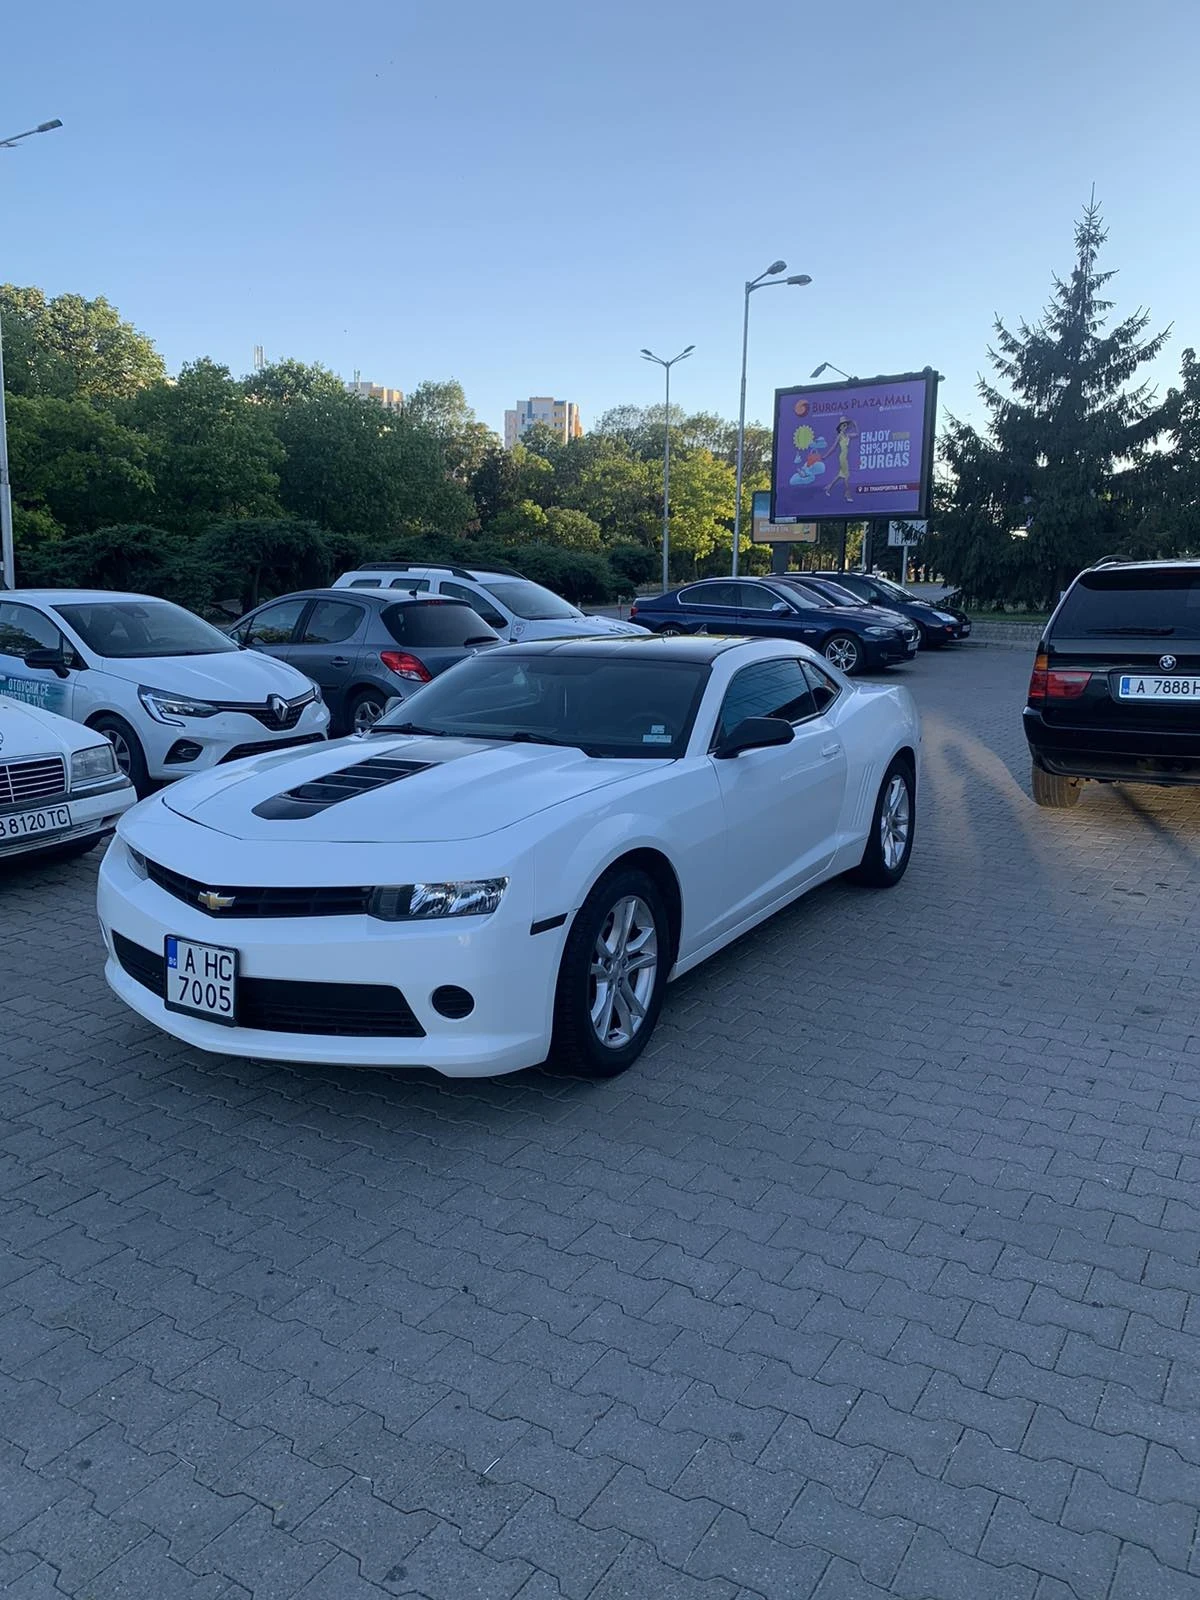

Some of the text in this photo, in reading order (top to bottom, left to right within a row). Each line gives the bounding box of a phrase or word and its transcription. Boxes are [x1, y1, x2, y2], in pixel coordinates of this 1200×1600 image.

[811, 400, 849, 413] BURGAS
[851, 397, 882, 409] PLAZA
[884, 394, 913, 406] MALL
[860, 430, 890, 443] ENJOY
[859, 452, 910, 470] BURGAS
[8, 678, 50, 697] ОТПУСНИ СЕ
[1136, 680, 1145, 694] A
[1154, 680, 1190, 695] 7888
[9, 813, 46, 834] 8120
[47, 809, 67, 827] TC
[184, 947, 233, 982] A HC
[178, 975, 232, 1013] 7005
